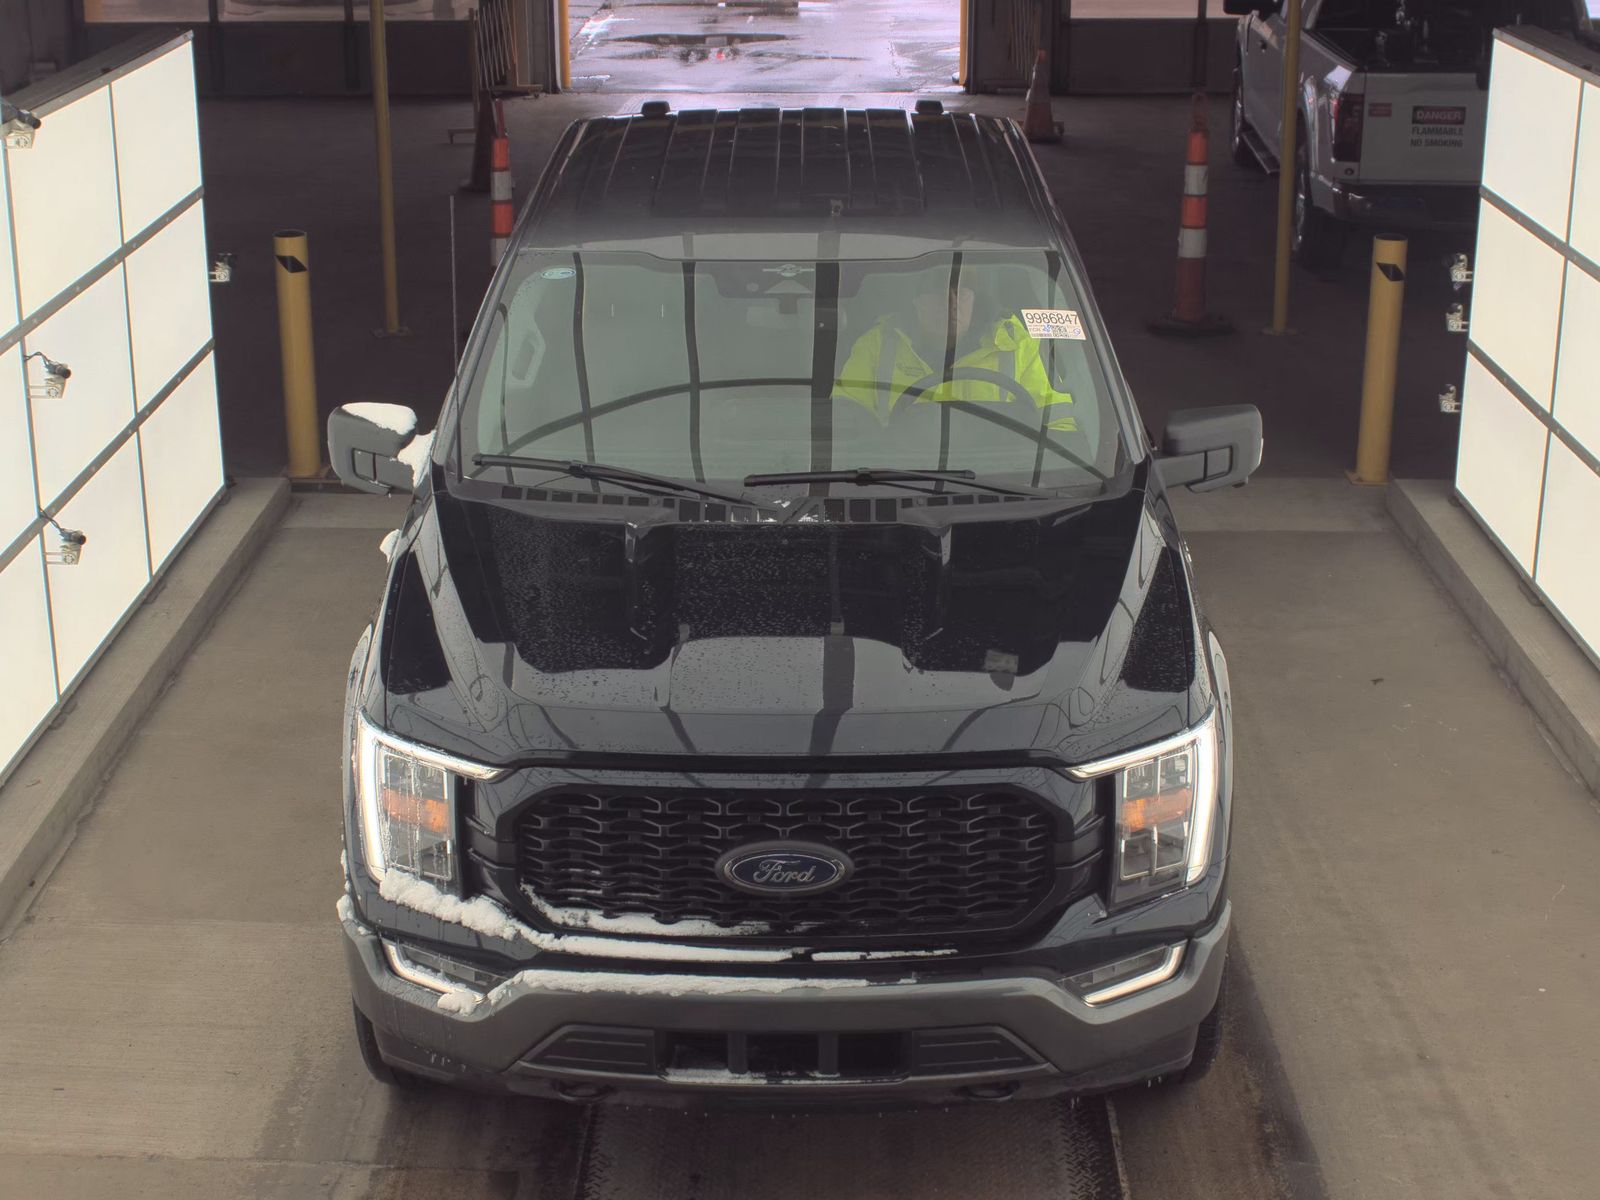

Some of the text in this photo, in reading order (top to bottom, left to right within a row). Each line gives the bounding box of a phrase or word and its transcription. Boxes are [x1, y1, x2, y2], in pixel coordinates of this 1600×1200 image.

[1416, 110, 1461, 120] DANGER
[1411, 126, 1463, 136] FLAMMABLE
[1410, 138, 1463, 148] NO SMOKING
[1025, 312, 1078, 325] 9986847
[753, 859, 816, 883] Ford
